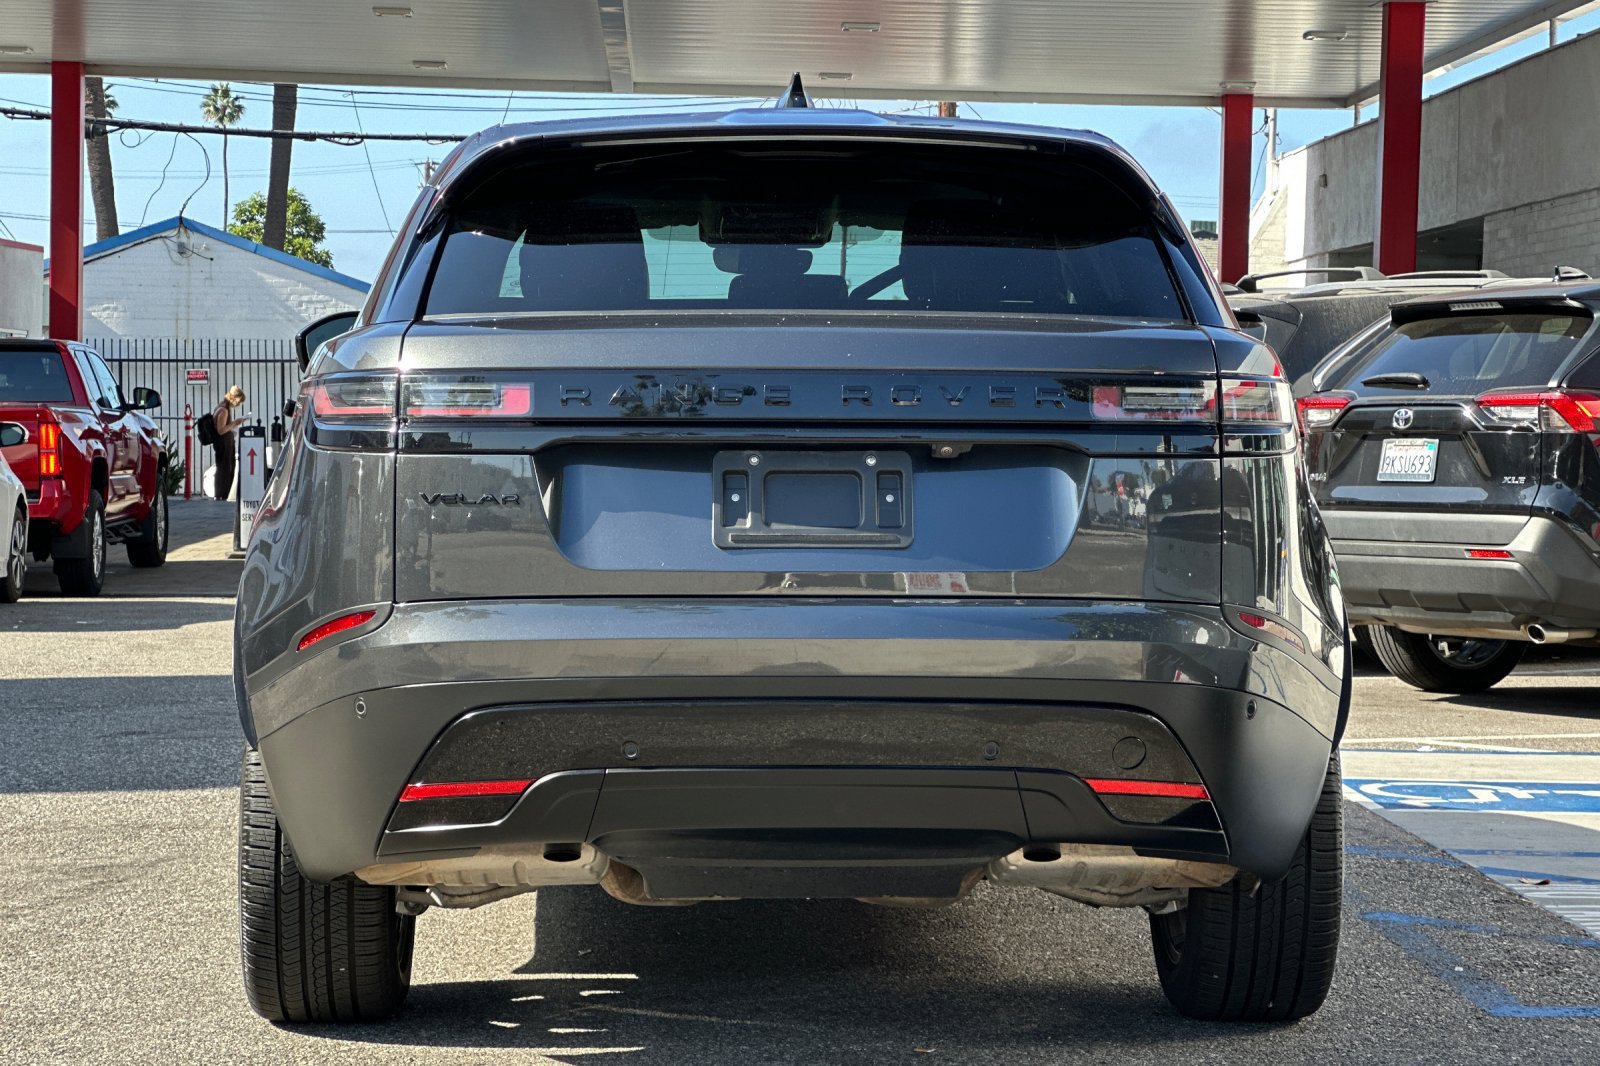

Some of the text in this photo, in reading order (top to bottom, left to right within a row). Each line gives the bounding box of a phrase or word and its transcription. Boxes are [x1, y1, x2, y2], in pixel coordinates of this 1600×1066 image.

[560, 384, 1067, 409] RANGE ROVER
[1383, 455, 1432, 473] 9KSU693
[1502, 476, 1526, 484] XLE
[243, 500, 259, 509] TOYOT
[418, 492, 521, 506] VELAR
